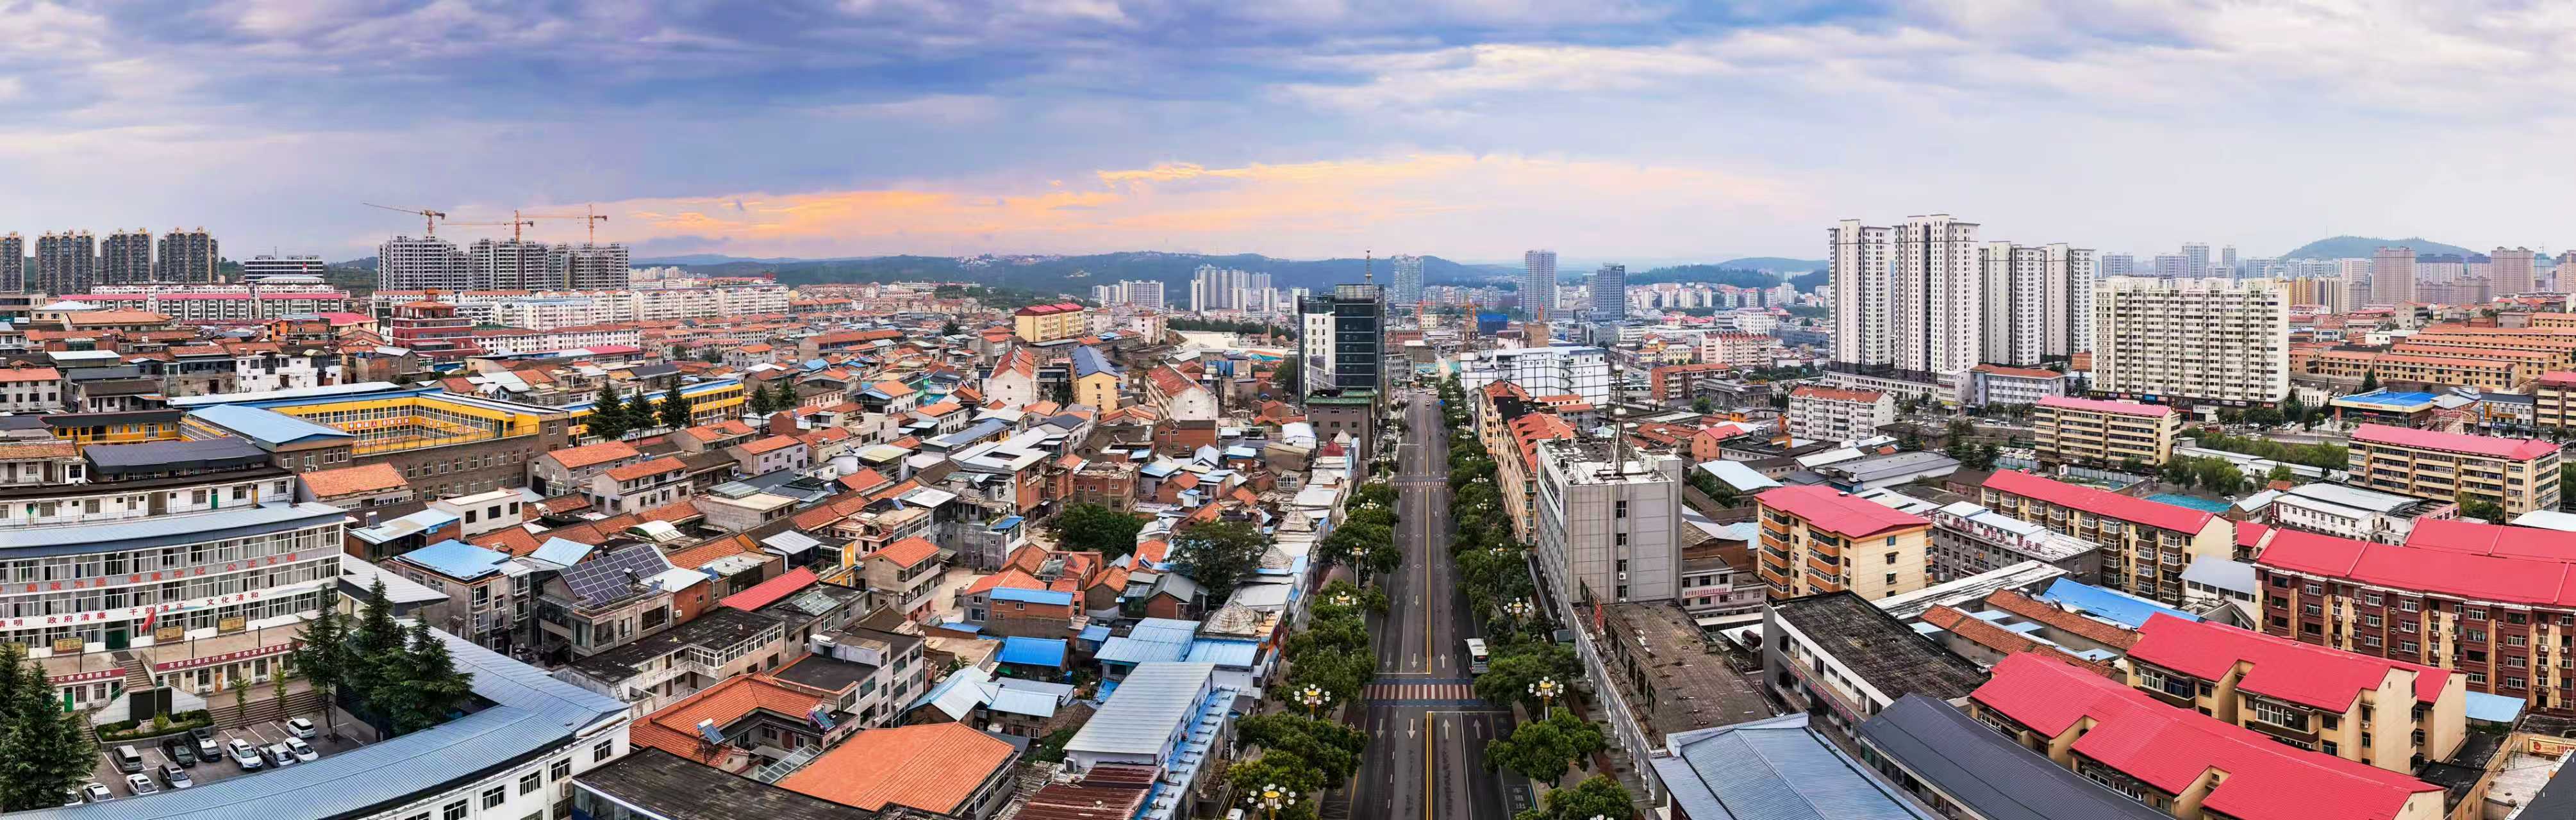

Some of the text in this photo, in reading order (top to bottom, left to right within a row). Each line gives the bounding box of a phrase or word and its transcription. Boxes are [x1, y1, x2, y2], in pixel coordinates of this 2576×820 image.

[227, 553, 296, 571] 公正文明
[47, 612, 106, 623] 政府清廉
[129, 603, 185, 616] 干部清正
[206, 592, 258, 605] 文化清和
